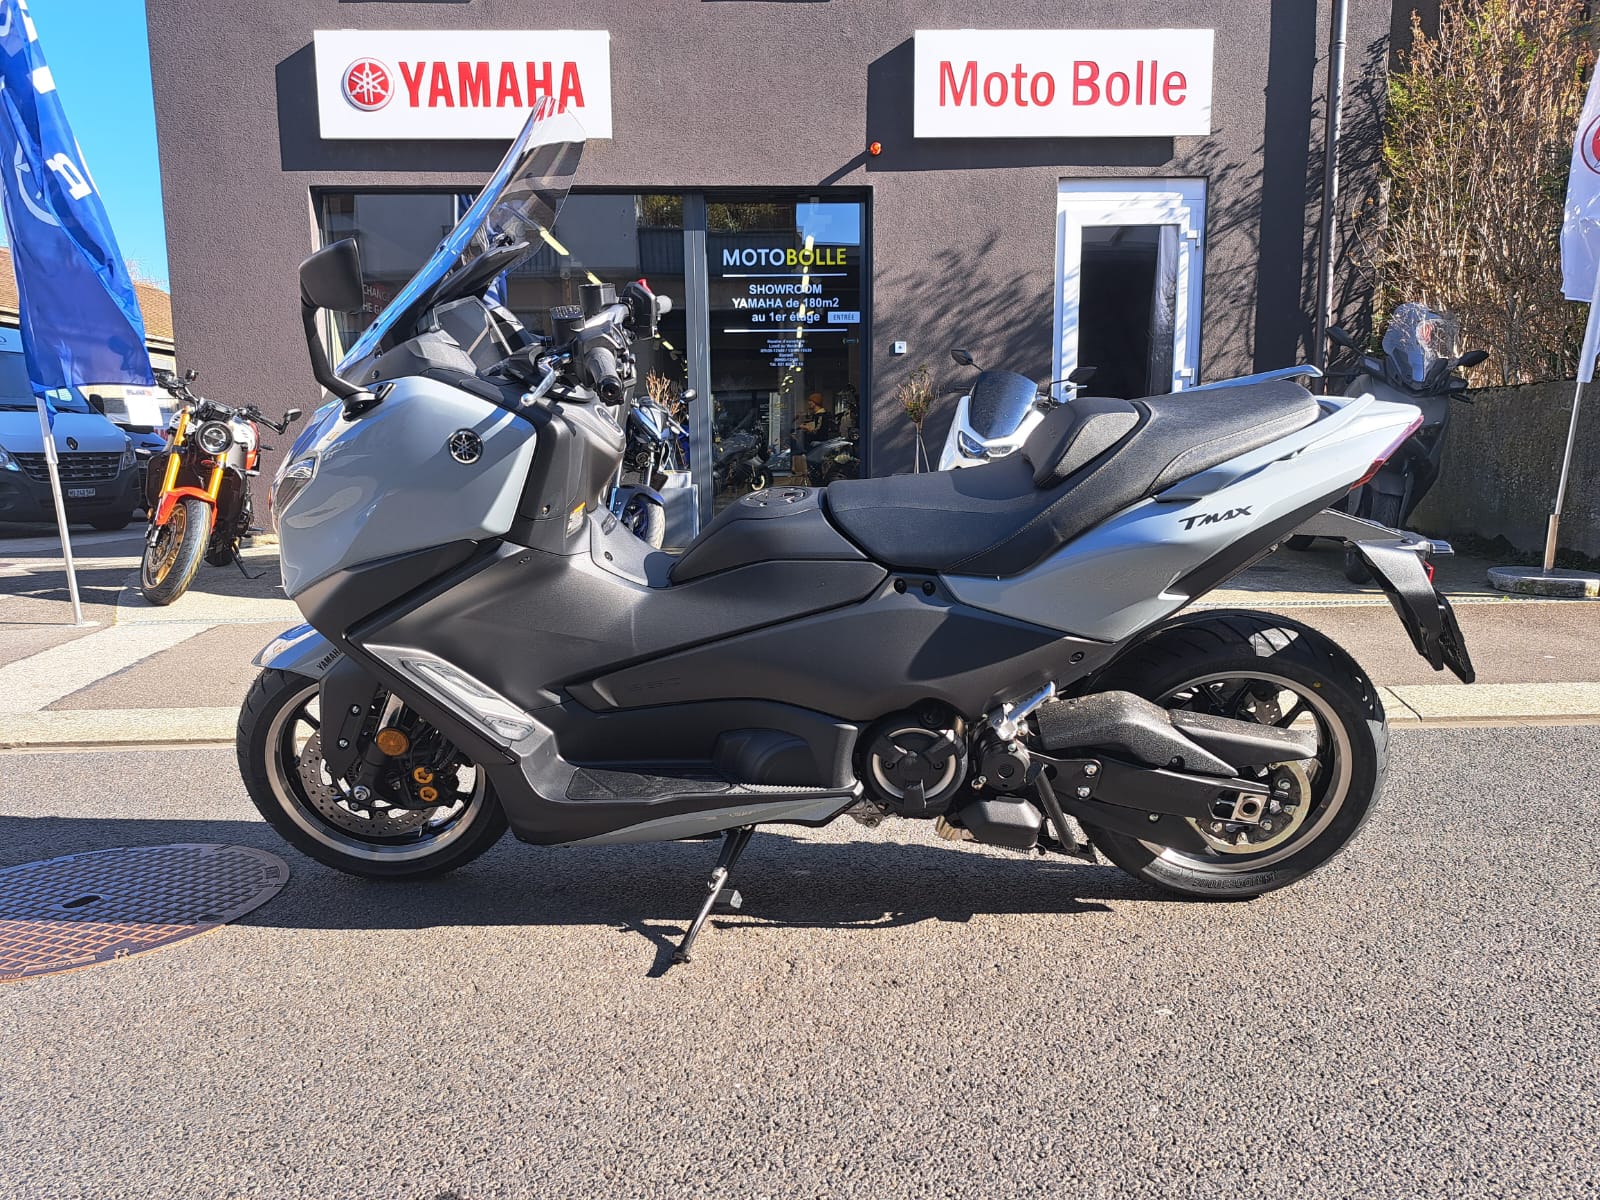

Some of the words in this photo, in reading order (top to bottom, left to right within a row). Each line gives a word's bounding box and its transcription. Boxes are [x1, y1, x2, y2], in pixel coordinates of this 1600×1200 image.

[398, 61, 585, 107] YAMAHA
[939, 60, 1055, 107] Moto
[1072, 60, 1187, 107] Bolle
[723, 248, 847, 267] MOTOBOLLE
[749, 283, 822, 295] SHOWROOM
[732, 297, 782, 309] YAMAHA
[785, 297, 799, 308] de
[803, 297, 840, 308] 180m2
[752, 313, 766, 322] au
[769, 312, 787, 322] 1er
[833, 312, 855, 321] ENTRÉE
[1178, 505, 1253, 531] TMAX
